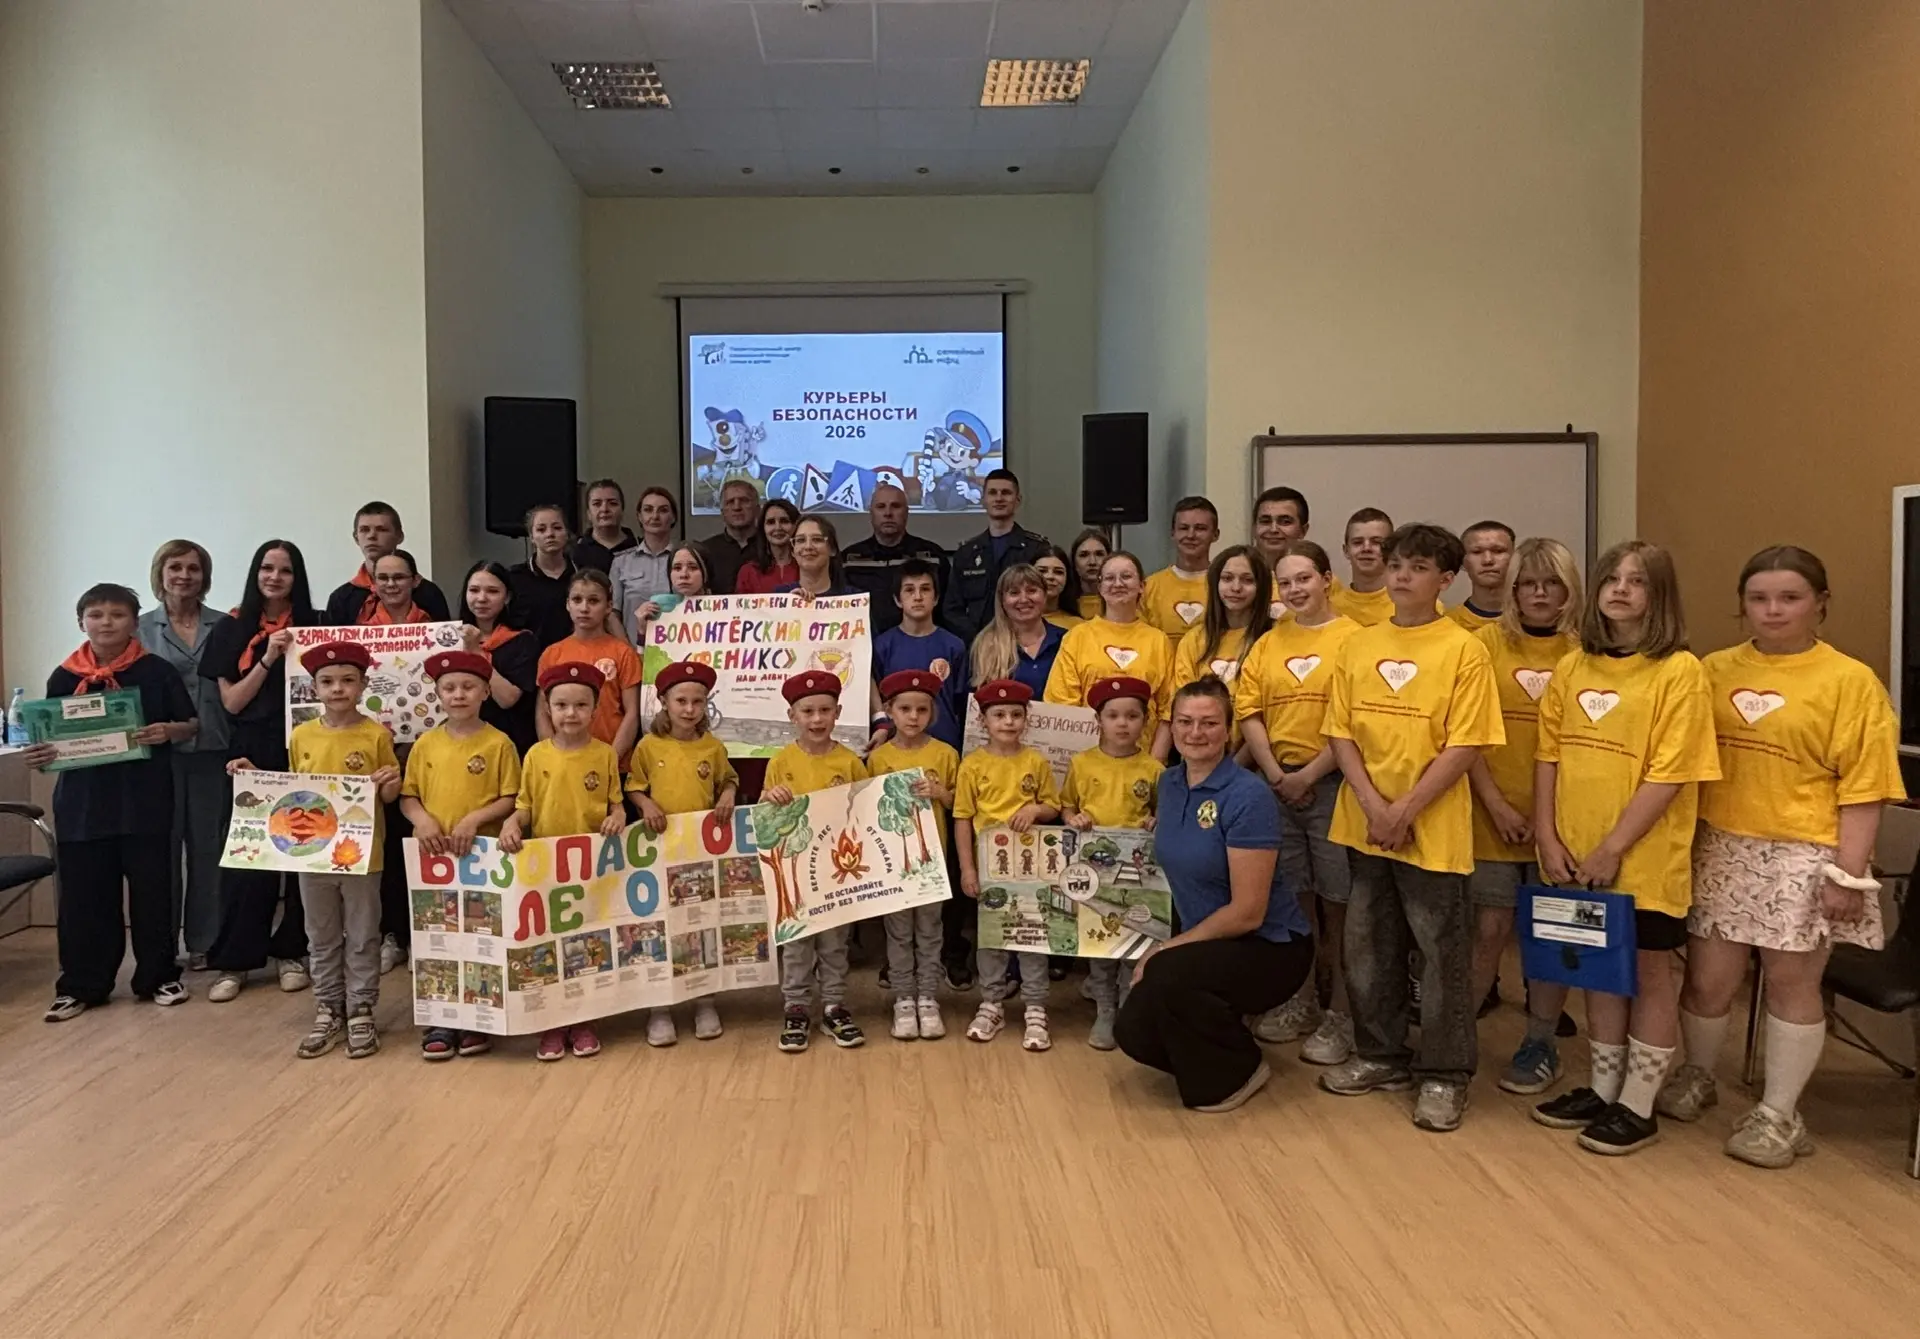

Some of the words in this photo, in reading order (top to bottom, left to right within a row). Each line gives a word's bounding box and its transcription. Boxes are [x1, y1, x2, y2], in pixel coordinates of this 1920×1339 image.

[803, 391, 886, 404] КУРЬЕРЫ
[772, 408, 917, 421] БЕЗОПАСНОСТИ
[824, 425, 866, 438] 2026
[684, 597, 729, 614] АКЦИЯ
[654, 616, 802, 644] ВОЛОНТЁРСКИЙ
[808, 619, 866, 642] ОТРЯД
[1027, 714, 1101, 737] ЕЗОПАСНОСТИ
[419, 806, 759, 889] БЕЗОПАСНОЕ
[809, 845, 820, 893] БЕРЕГИТЕ
[817, 824, 832, 841] ЛЕС
[866, 825, 877, 836] ОТ
[874, 836, 893, 874] ПОЖАРА
[808, 901, 836, 917] КОСТЕР
[838, 897, 853, 907] БЕЗ
[856, 885, 904, 902] ПРИСМОТРА
[824, 891, 834, 901] НЕ
[835, 880, 884, 898] ОСТАВЛЯЙТЕ
[513, 869, 660, 942] ЛЕТО
